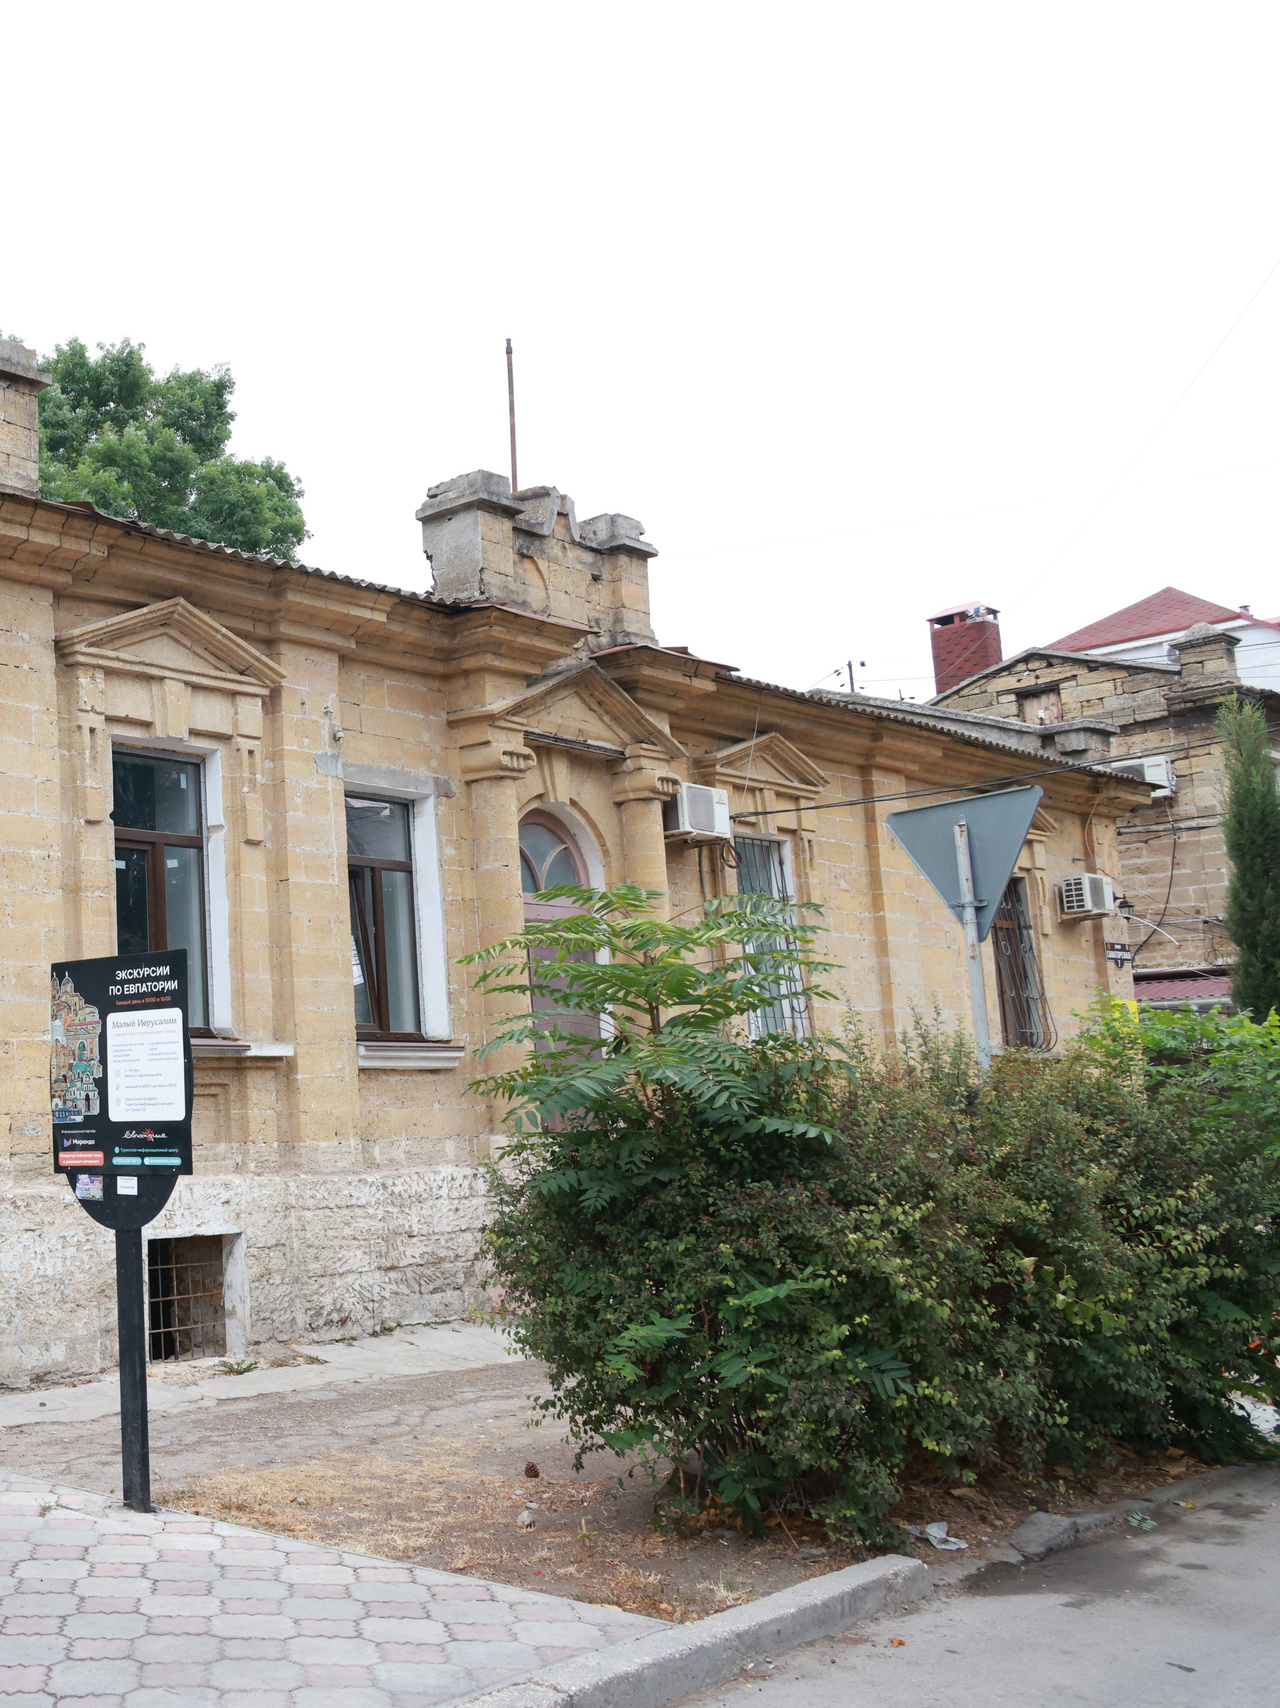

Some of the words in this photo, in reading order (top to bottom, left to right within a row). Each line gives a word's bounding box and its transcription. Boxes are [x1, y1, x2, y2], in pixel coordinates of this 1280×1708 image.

[115, 966, 170, 980] ЭКСКУРСИИ
[108, 985, 122, 996] ПО
[124, 980, 178, 994] ЕВПАТОРИИ
[112, 1020, 136, 1030] Малый
[137, 1018, 177, 1028] Иерусалим
